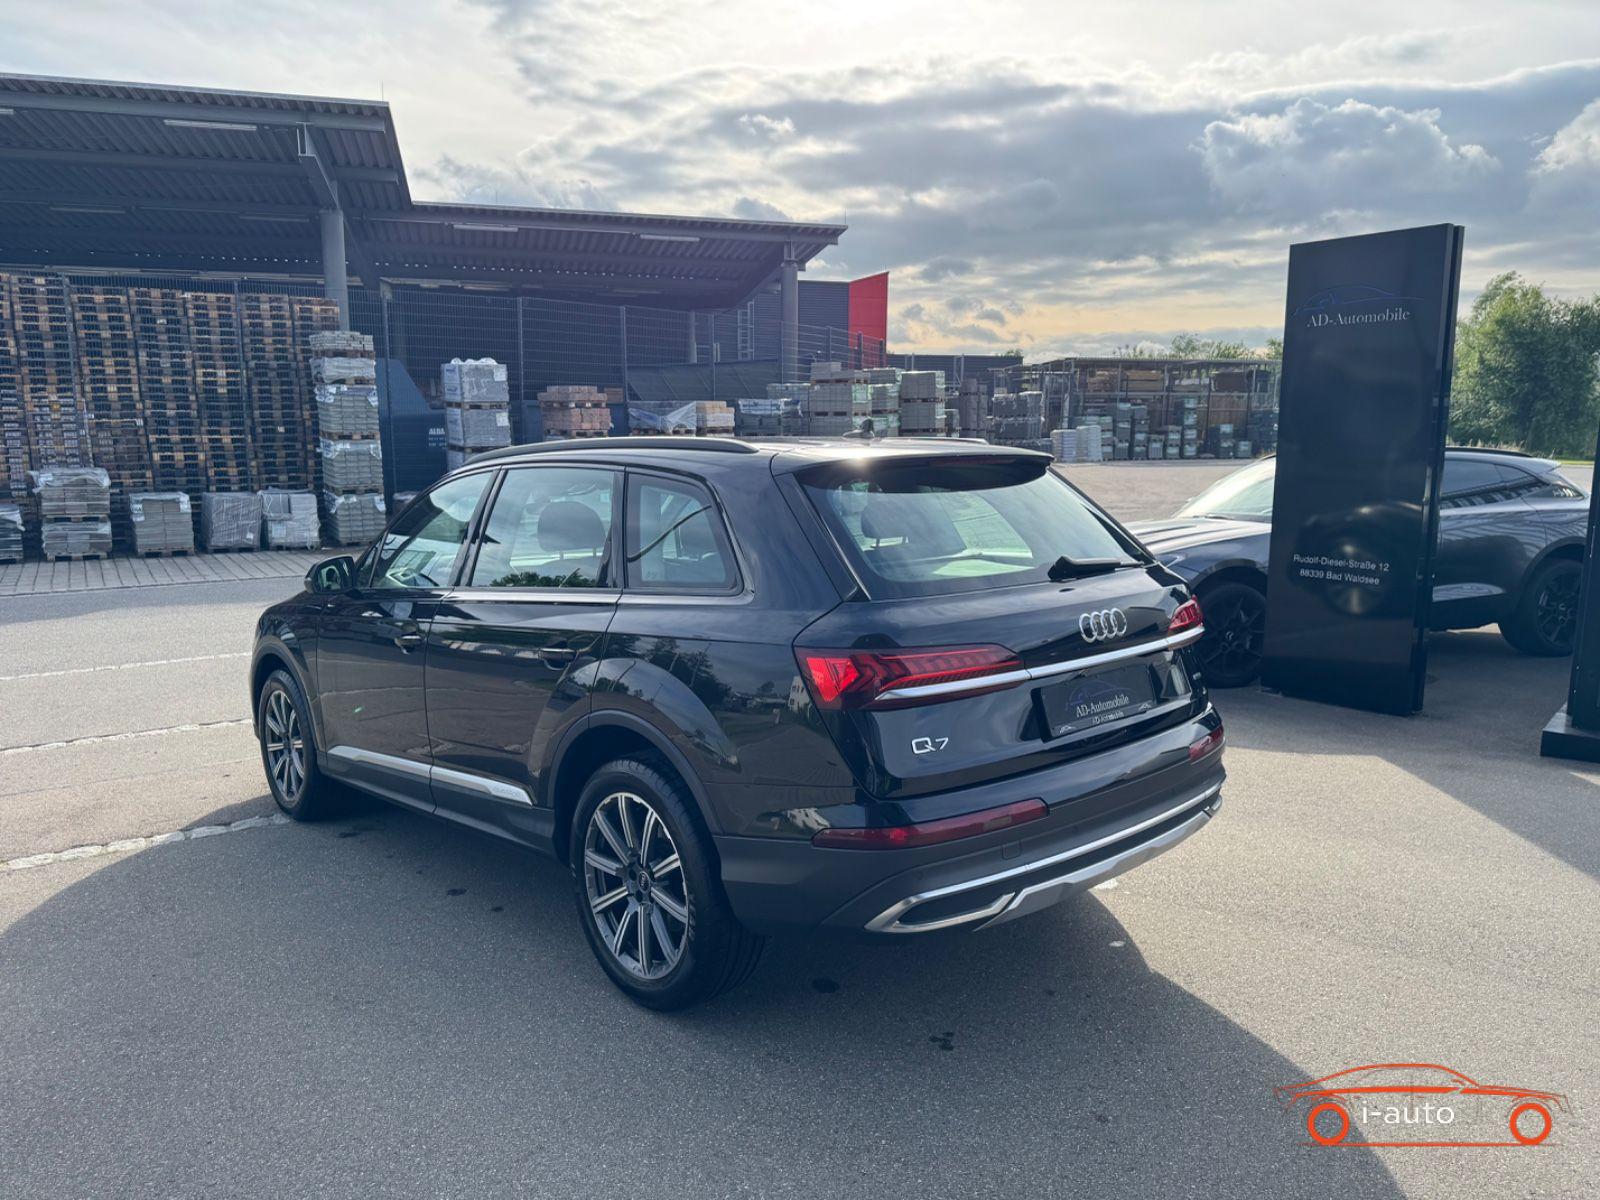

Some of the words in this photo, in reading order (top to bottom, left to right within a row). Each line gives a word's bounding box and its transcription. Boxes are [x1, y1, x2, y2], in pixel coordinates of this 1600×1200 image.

[1306, 307, 1410, 327] AD-Automobile
[1378, 562, 1390, 572] 12
[1325, 571, 1342, 581] Bad
[1344, 573, 1380, 585] Waldsee
[1076, 693, 1129, 718] AD-Automobile
[911, 737, 949, 754] Q7
